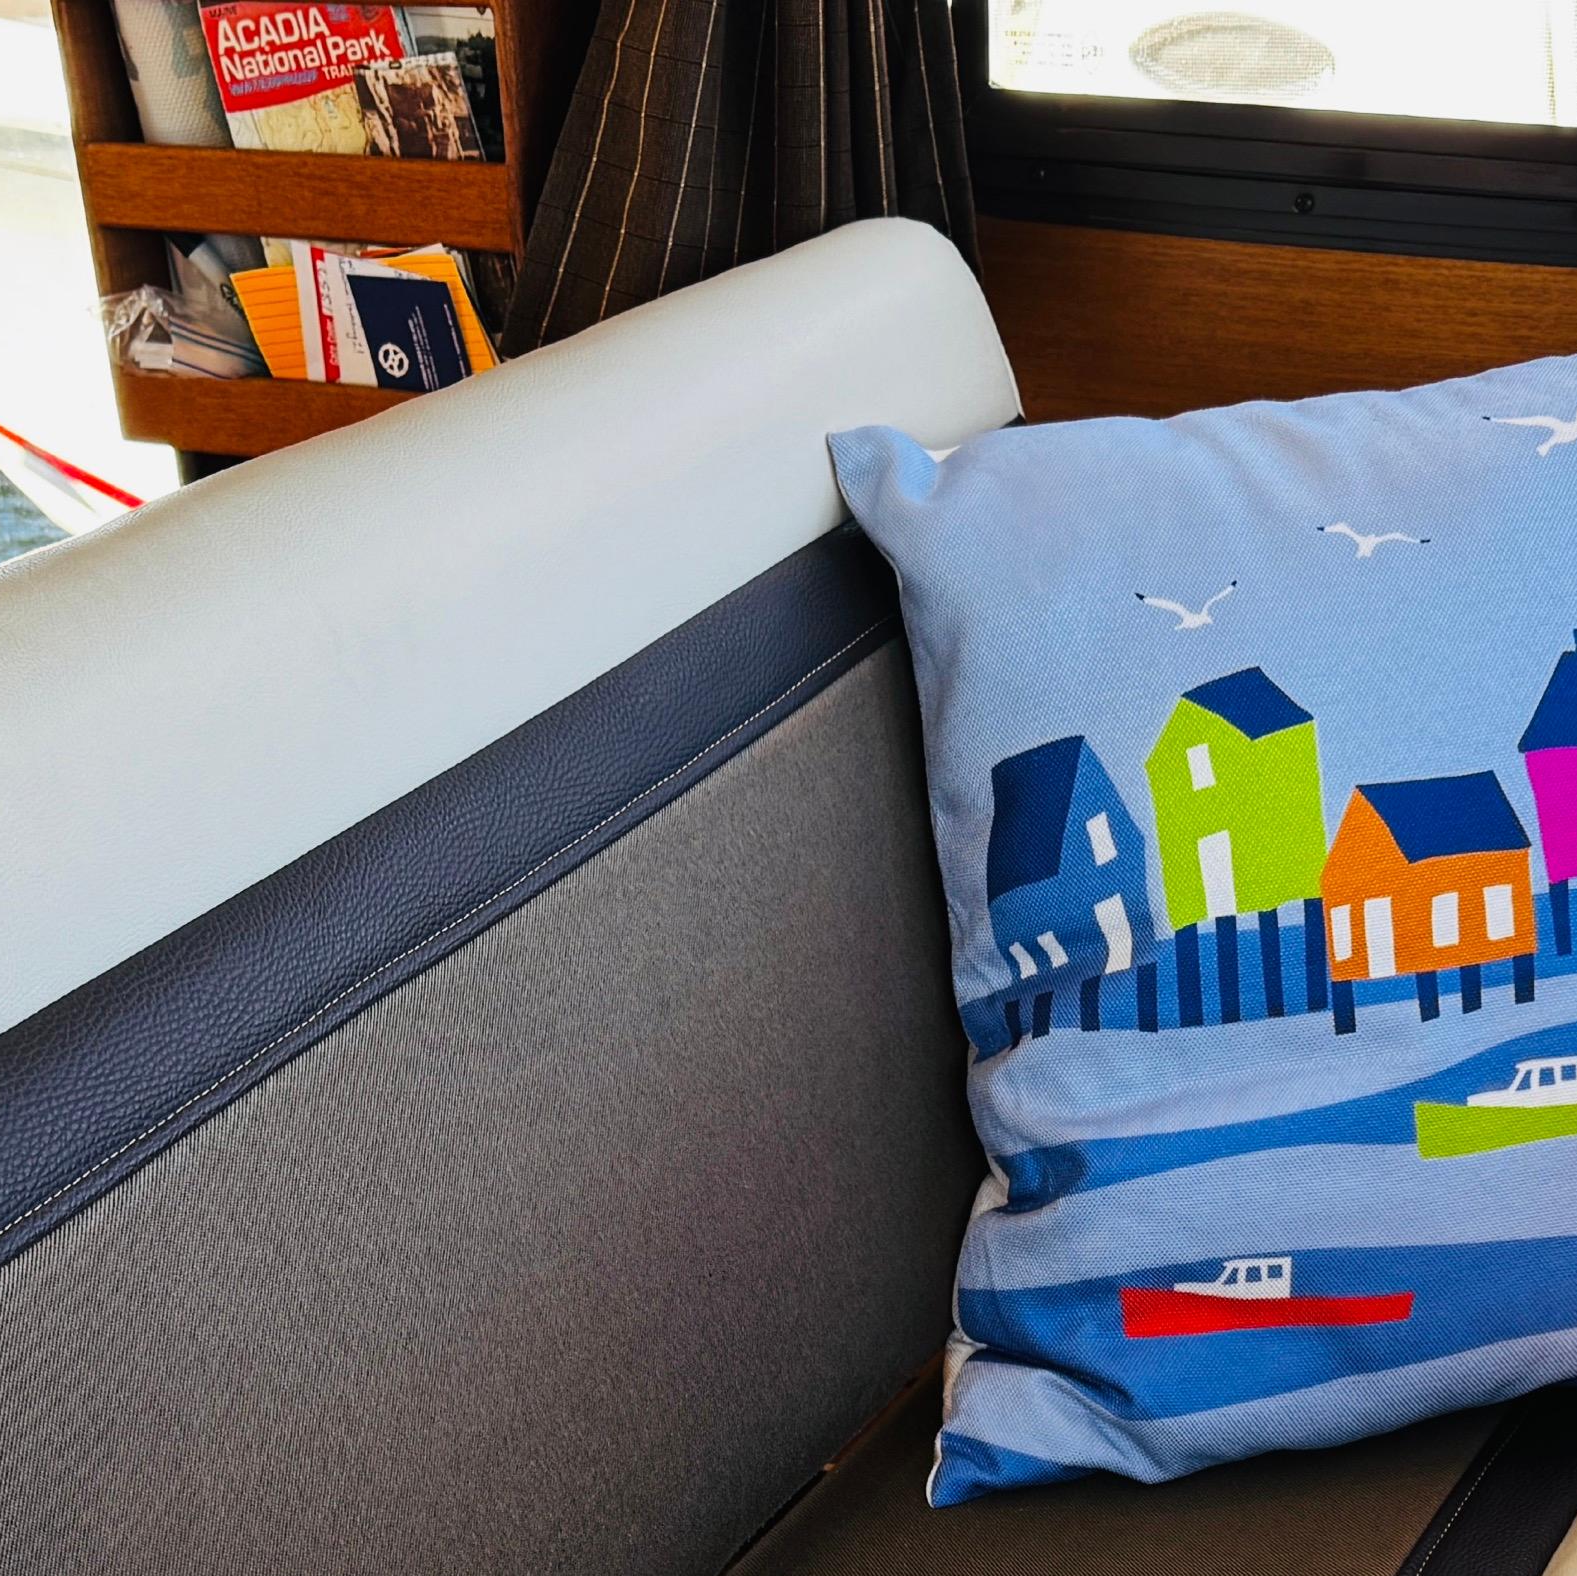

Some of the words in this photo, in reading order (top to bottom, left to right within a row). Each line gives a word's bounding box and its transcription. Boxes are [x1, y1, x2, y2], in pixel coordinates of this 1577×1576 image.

[218, 7, 330, 55] ACADIA
[220, 38, 326, 83] National
[326, 28, 391, 64] Park
[321, 60, 356, 81] TRAI
